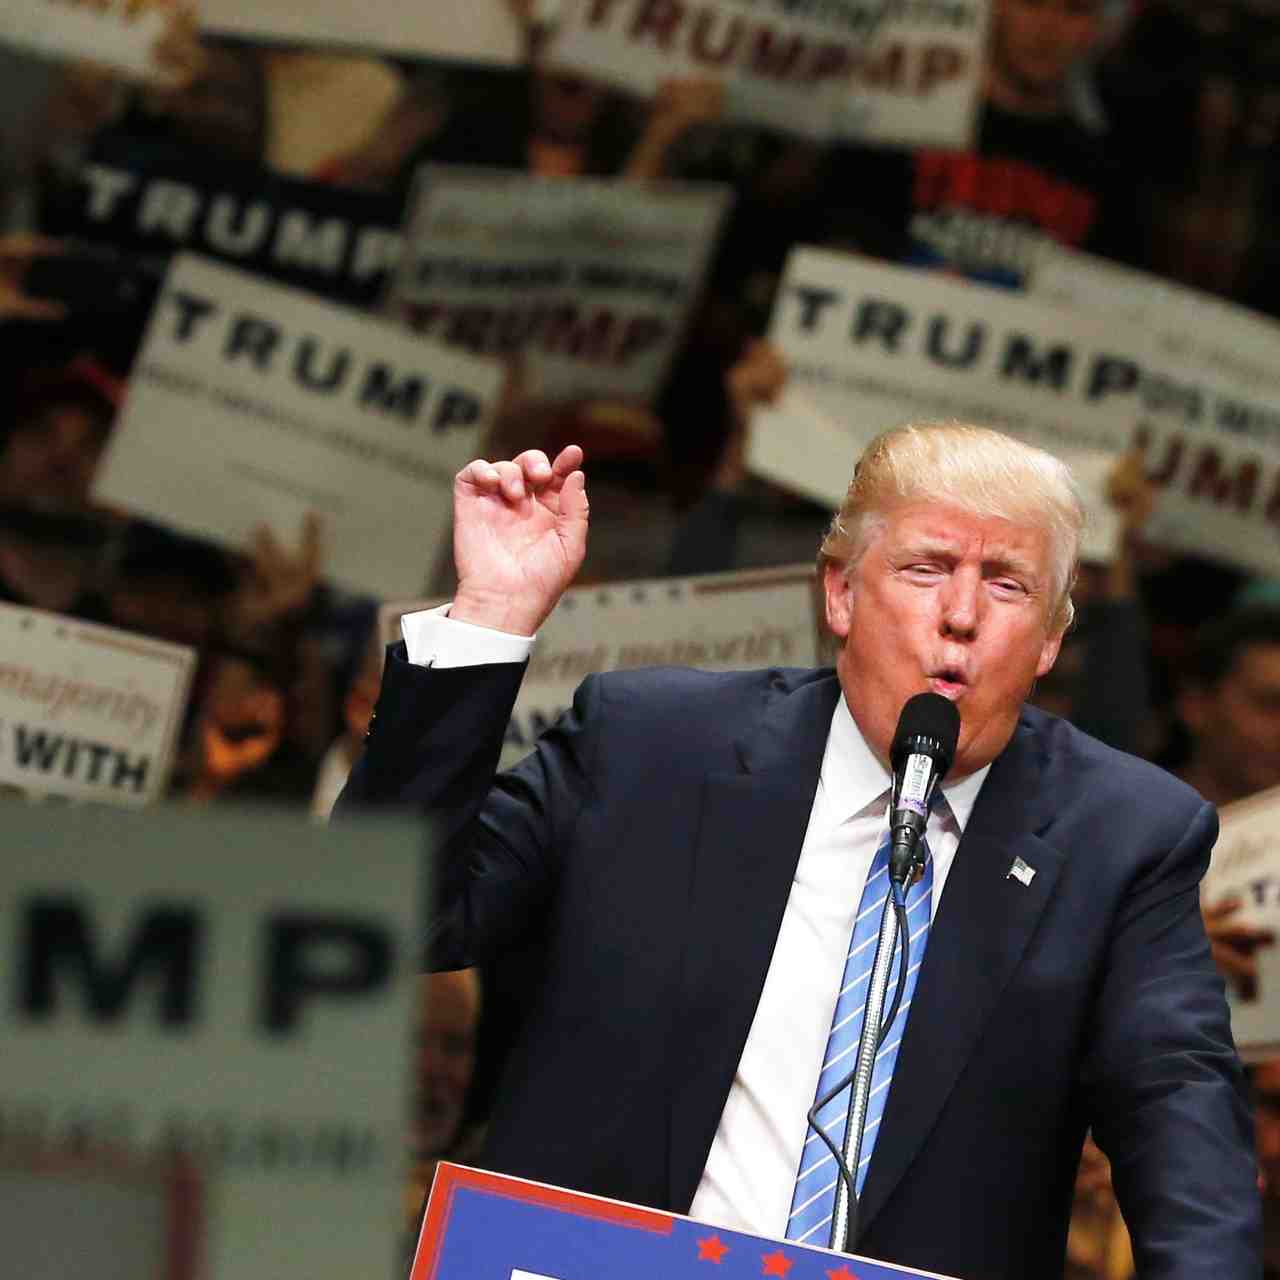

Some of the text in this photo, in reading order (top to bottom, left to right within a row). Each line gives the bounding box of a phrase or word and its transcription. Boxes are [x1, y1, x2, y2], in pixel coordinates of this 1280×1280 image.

[170, 293, 484, 434] TRUMP
[794, 287, 1142, 402] TRUMP
[15, 722, 151, 795] WITH
